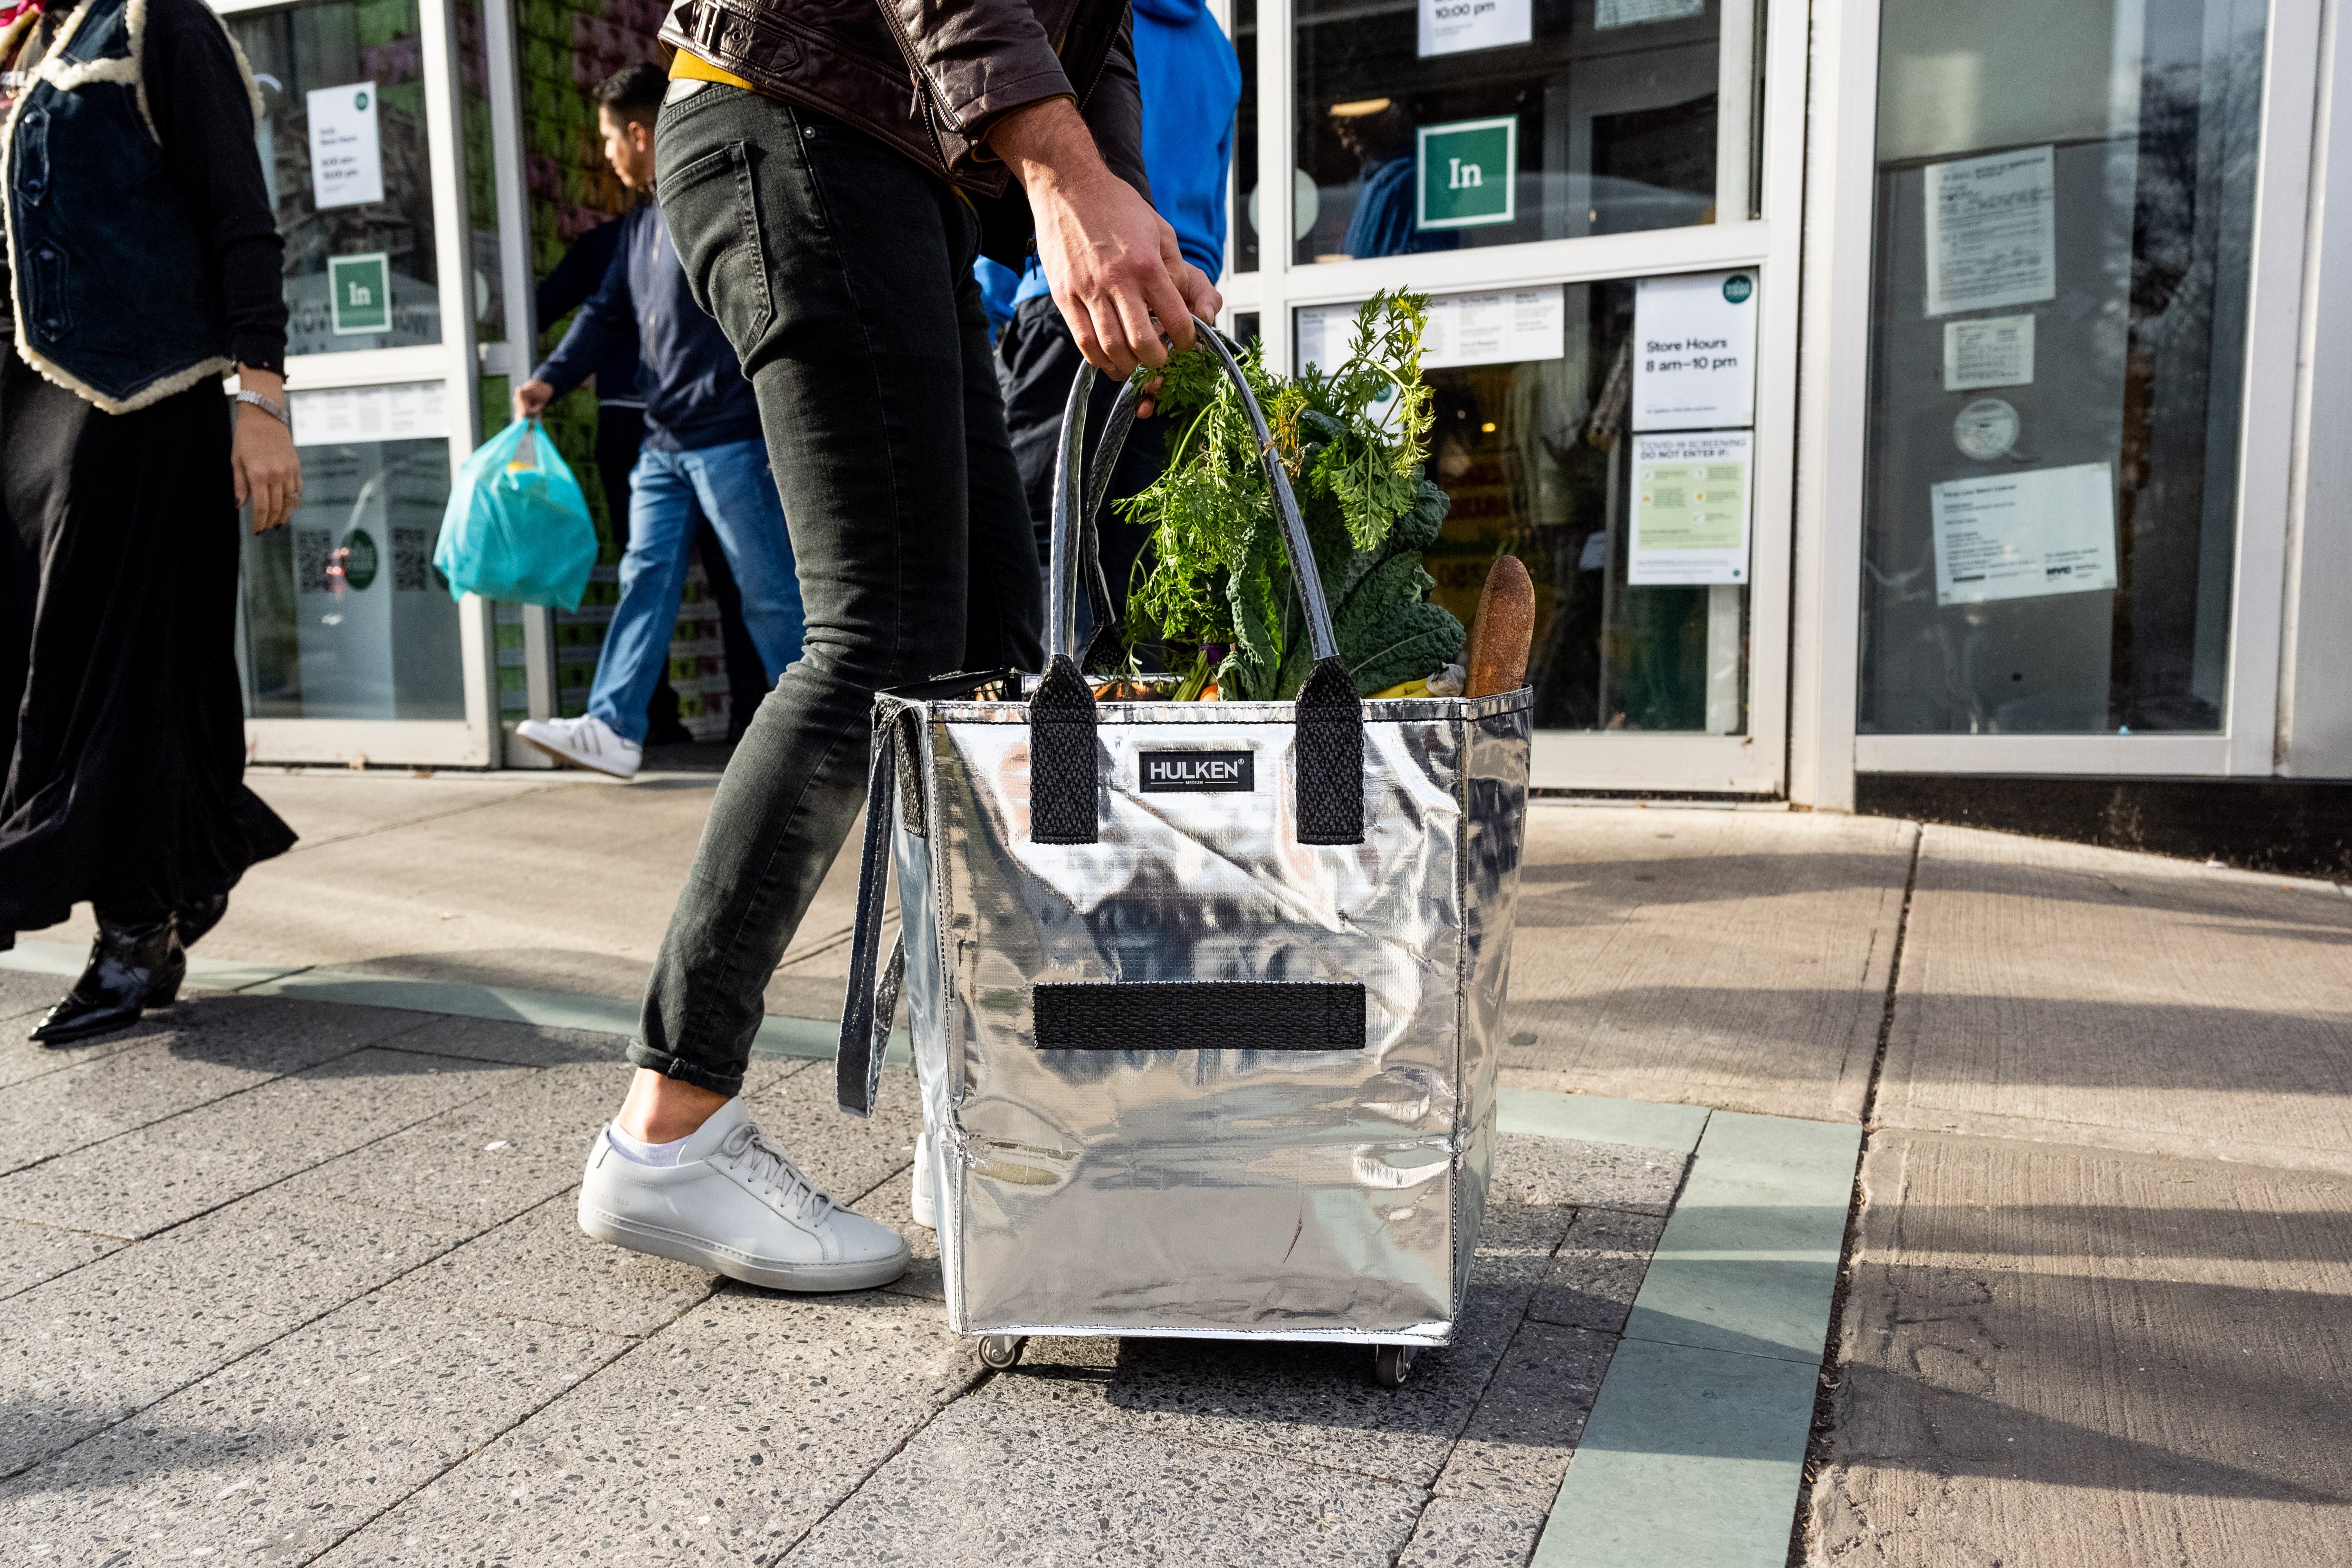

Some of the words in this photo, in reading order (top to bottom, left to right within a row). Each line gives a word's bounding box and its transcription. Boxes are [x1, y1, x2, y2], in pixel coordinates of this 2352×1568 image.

[1435, 3, 1471, 19] 10:00
[1474, 1, 1496, 16] pm
[1448, 158, 1482, 189] In
[348, 281, 372, 306] In
[1647, 339, 1682, 353] Store
[1686, 337, 1728, 350] Hours
[1646, 360, 1654, 373] 8
[1712, 357, 1737, 371] pm
[1640, 450, 1656, 459] DO
[1659, 450, 1679, 459] NOT
[1683, 449, 1714, 458] ENTER
